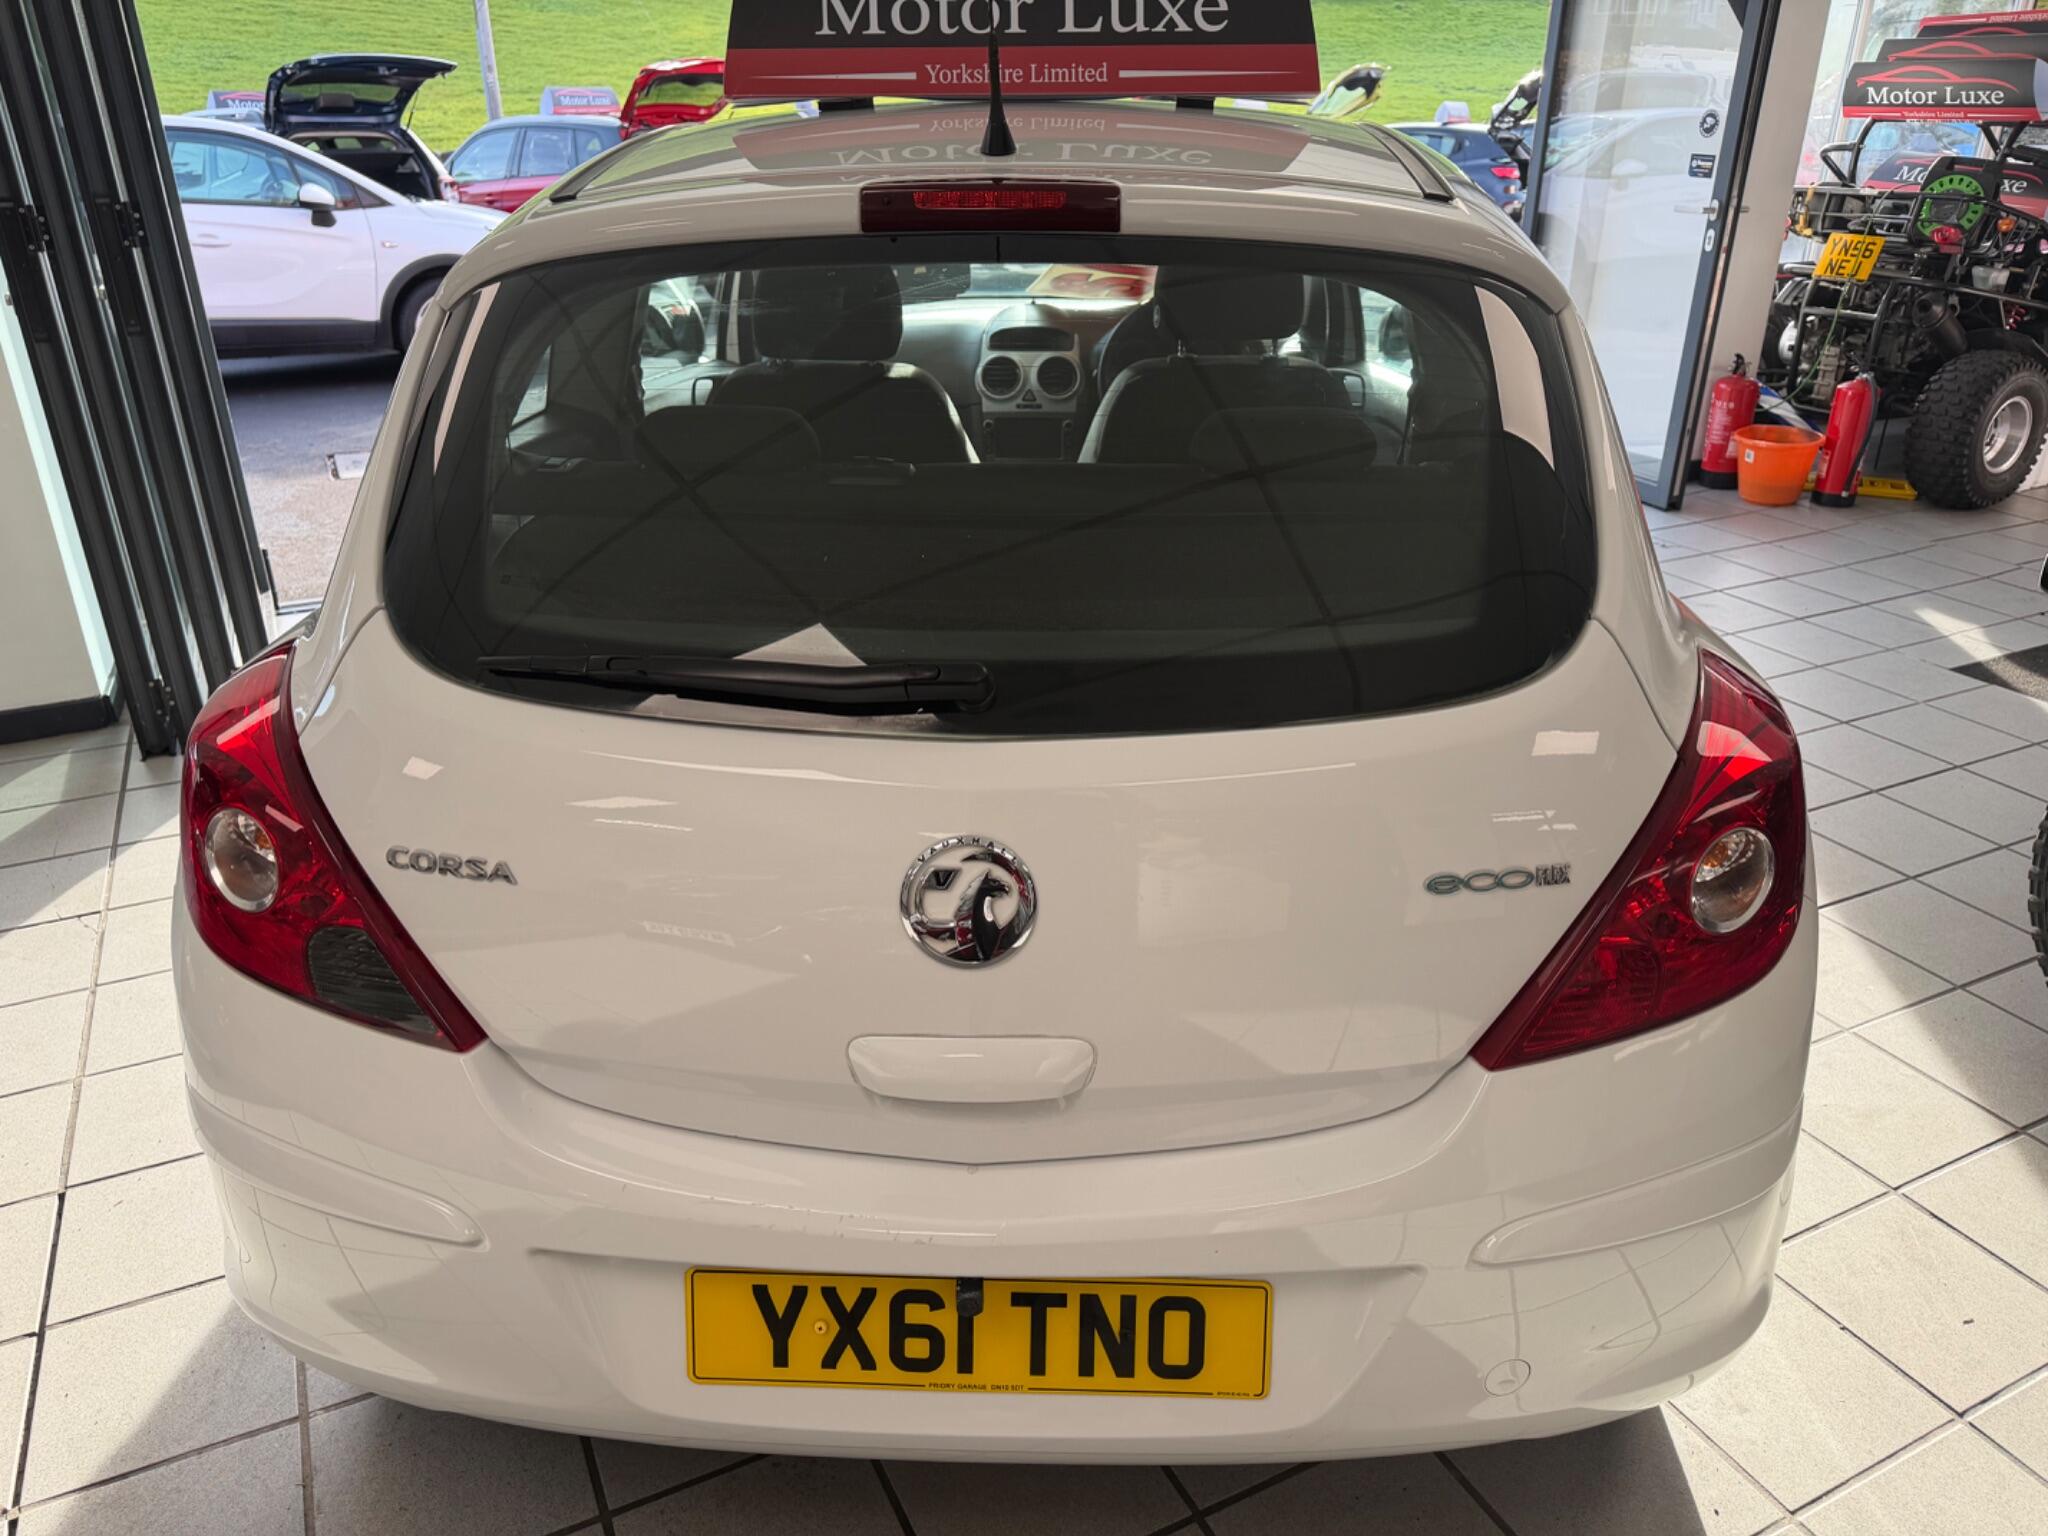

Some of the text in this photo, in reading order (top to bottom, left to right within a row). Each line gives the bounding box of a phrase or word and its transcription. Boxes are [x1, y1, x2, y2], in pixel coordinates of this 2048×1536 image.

[815, 0, 1229, 36] Motor Luxe
[1030, 61, 1108, 83] Limited
[1866, 86, 2005, 105] Motor Luxe
[386, 846, 518, 886] CORSA
[752, 1284, 1206, 1380] YX61 TNO
